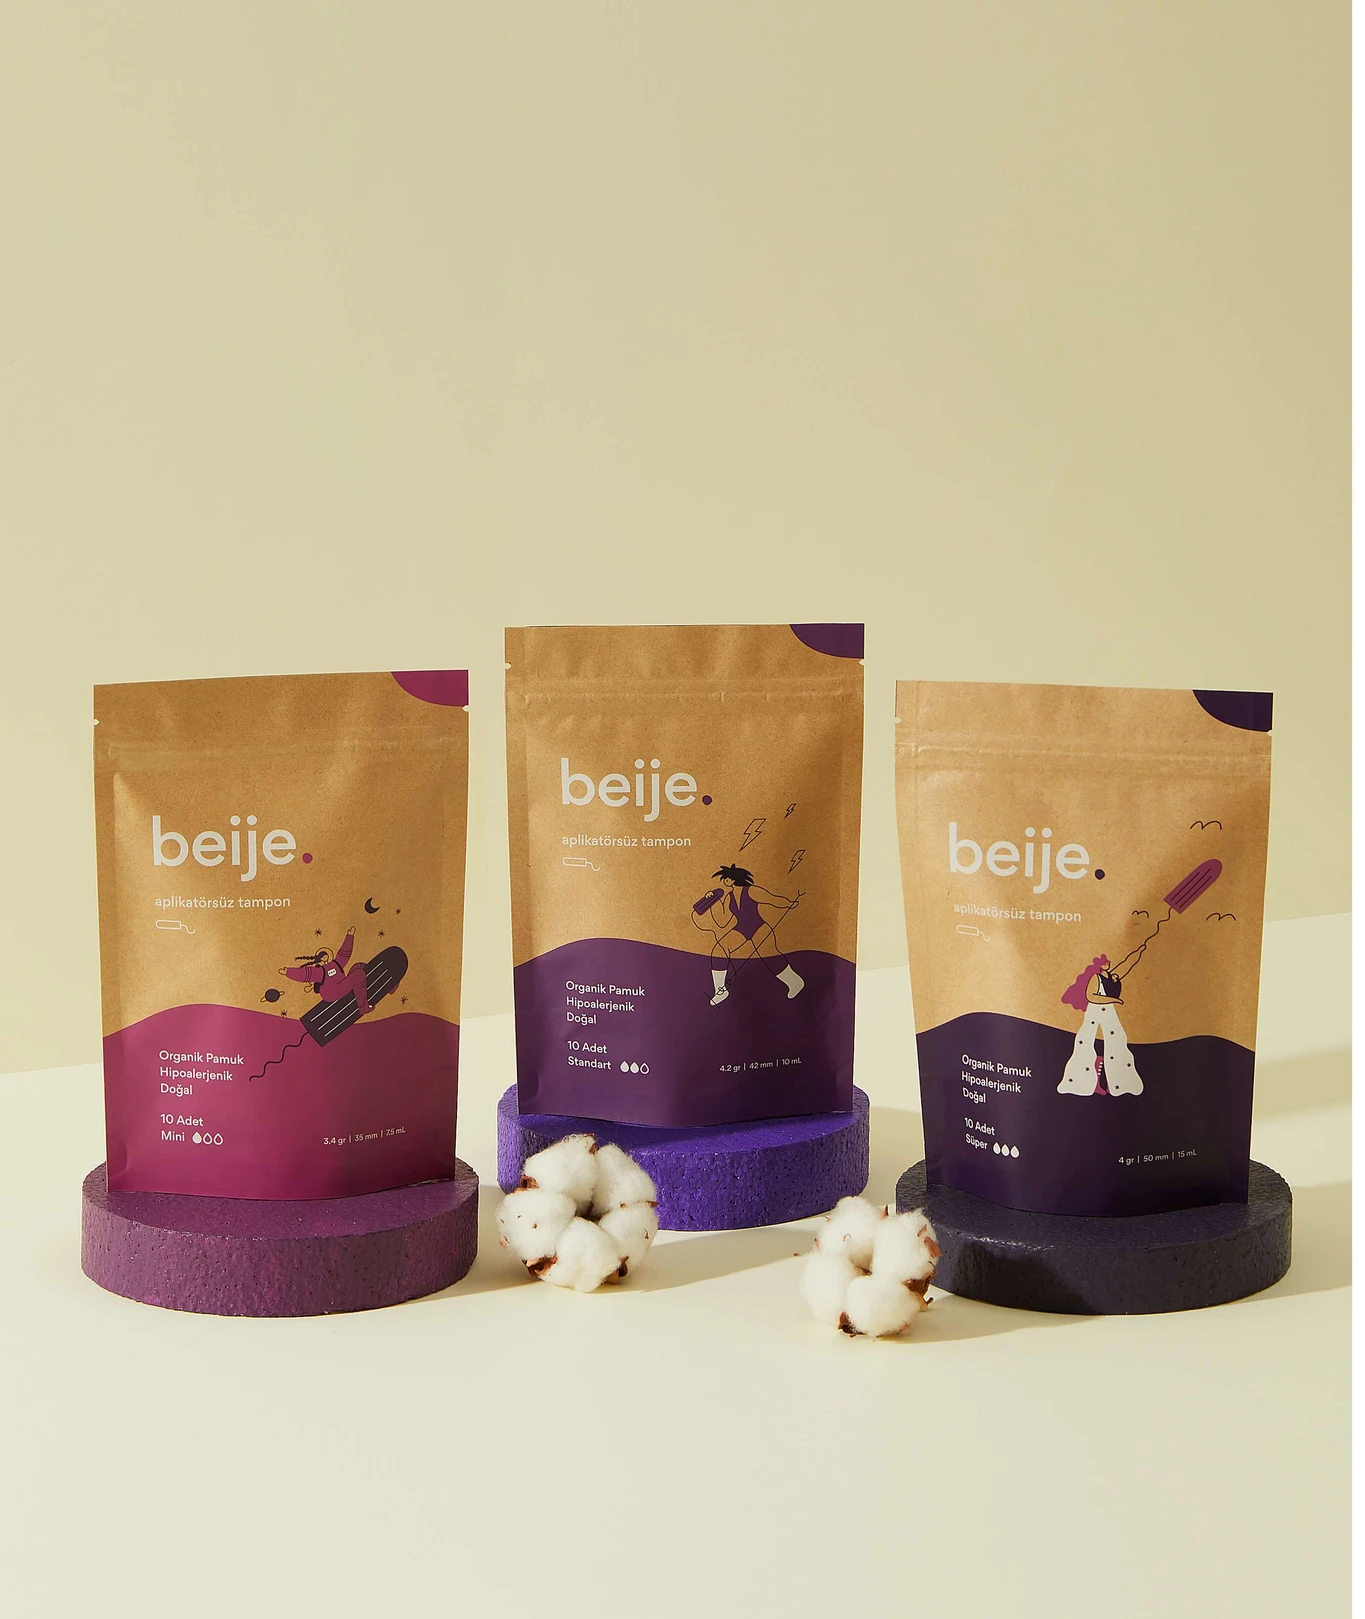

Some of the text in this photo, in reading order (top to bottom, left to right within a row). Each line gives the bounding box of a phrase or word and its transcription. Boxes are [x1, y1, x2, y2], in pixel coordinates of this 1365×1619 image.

[561, 757, 713, 822] beije.
[152, 814, 313, 882] beije.
[562, 834, 691, 849] aplikatörsüz tampon
[949, 821, 1106, 894] beije.
[155, 896, 291, 910] aplikatörsüz tampon
[953, 903, 1081, 924] aplikatörsüz tampon
[565, 980, 645, 996] Organik Pamuk
[566, 996, 635, 1012] Hipoalerjenik
[566, 1012, 597, 1026] Doğal
[567, 1040, 607, 1054] 10 Adet
[159, 1050, 244, 1064] Organik Pamuk
[568, 1055, 612, 1069] Standart
[719, 1064, 732, 1072] 4.2
[733, 1065, 741, 1073] gr
[782, 1058, 790, 1066] 10
[962, 1054, 1032, 1077] Organik Pamuk
[160, 1066, 233, 1082] Hipoalerjenik
[961, 1071, 1021, 1093] Hipoalerjenik
[160, 1083, 192, 1097] Doğal
[962, 1087, 986, 1104] Doğal
[160, 1114, 204, 1126] 10 Adet
[964, 1117, 995, 1135] 10 Adet
[161, 1130, 185, 1142] Mini
[323, 1137, 336, 1145] 3.4
[338, 1138, 346, 1146] gr
[354, 1133, 364, 1142] 35
[386, 1128, 395, 1136] 7.5
[395, 1126, 406, 1134] mL
[965, 1133, 988, 1150] Süper
[1118, 1156, 1124, 1164] 4
[1126, 1158, 1134, 1166] gr
[1143, 1154, 1154, 1162] 50
[1178, 1150, 1185, 1158] 15
[1186, 1149, 1197, 1157] mL
